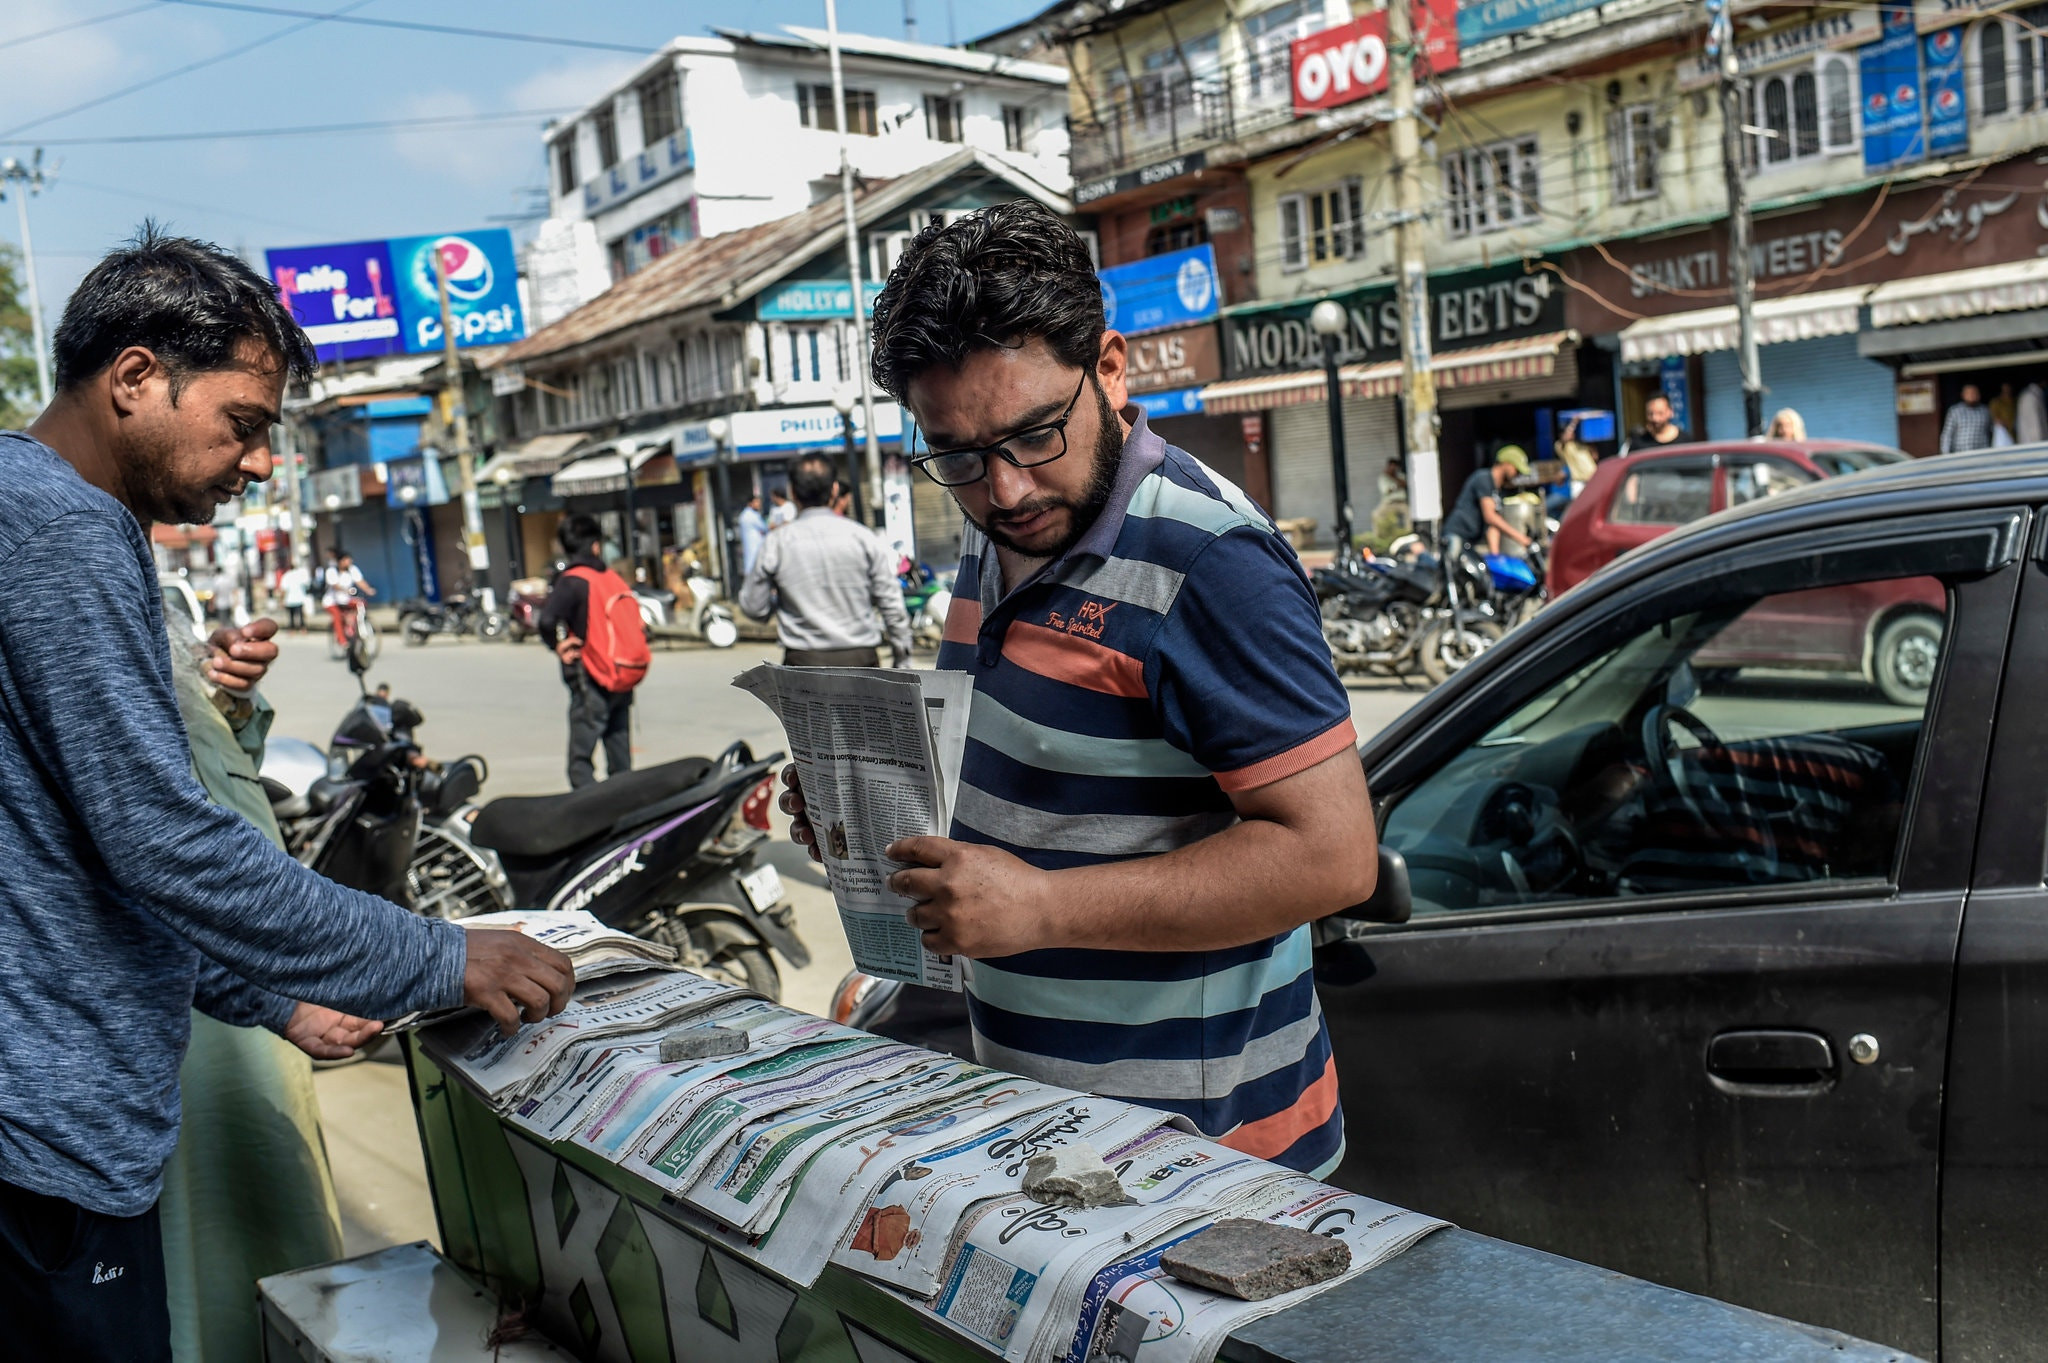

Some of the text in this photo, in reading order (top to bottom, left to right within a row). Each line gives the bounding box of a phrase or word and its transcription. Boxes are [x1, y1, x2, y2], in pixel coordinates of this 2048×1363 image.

[1298, 33, 1387, 101] OYO
[1140, 158, 1185, 184] SONY
[1075, 177, 1117, 203] SONY
[1629, 250, 1720, 299] SHAKTI
[1380, 275, 1541, 348] SEETS
[1077, 600, 1118, 625] HRX
[1065, 617, 1104, 639] Spirited
[879, 757, 897, 767] against
[856, 877, 882, 885] welcomed
[867, 868, 879, 877] Vice
[852, 885, 881, 895] Abrogation
